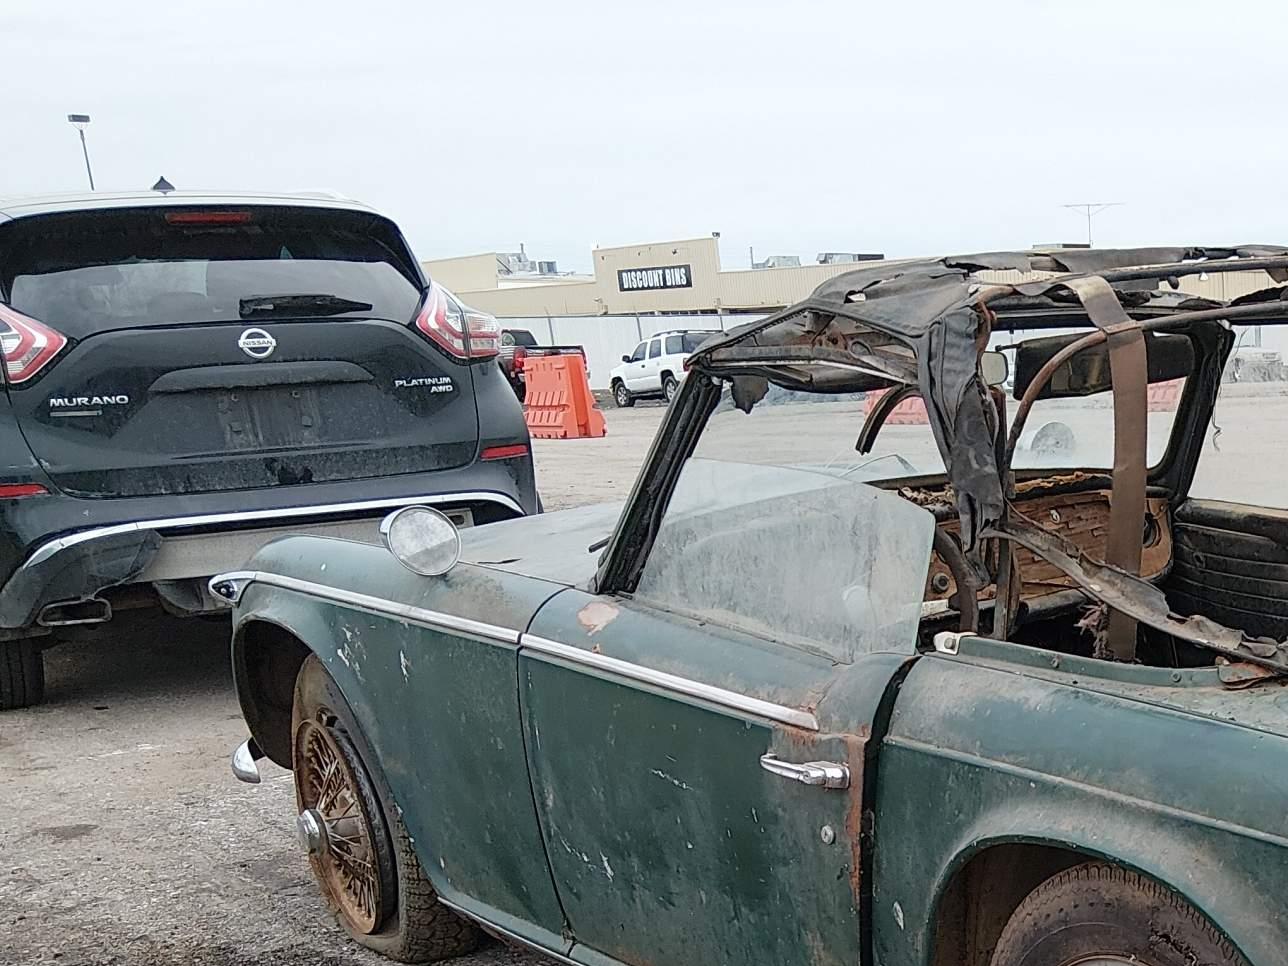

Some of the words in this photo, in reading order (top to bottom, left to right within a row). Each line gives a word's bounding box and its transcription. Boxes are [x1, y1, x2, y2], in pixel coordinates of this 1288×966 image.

[622, 269, 664, 288] DISCOUNT
[665, 267, 687, 286] BINS
[394, 376, 452, 388] PLATINUM
[430, 384, 454, 394] AWD
[49, 394, 129, 408] MURANO
